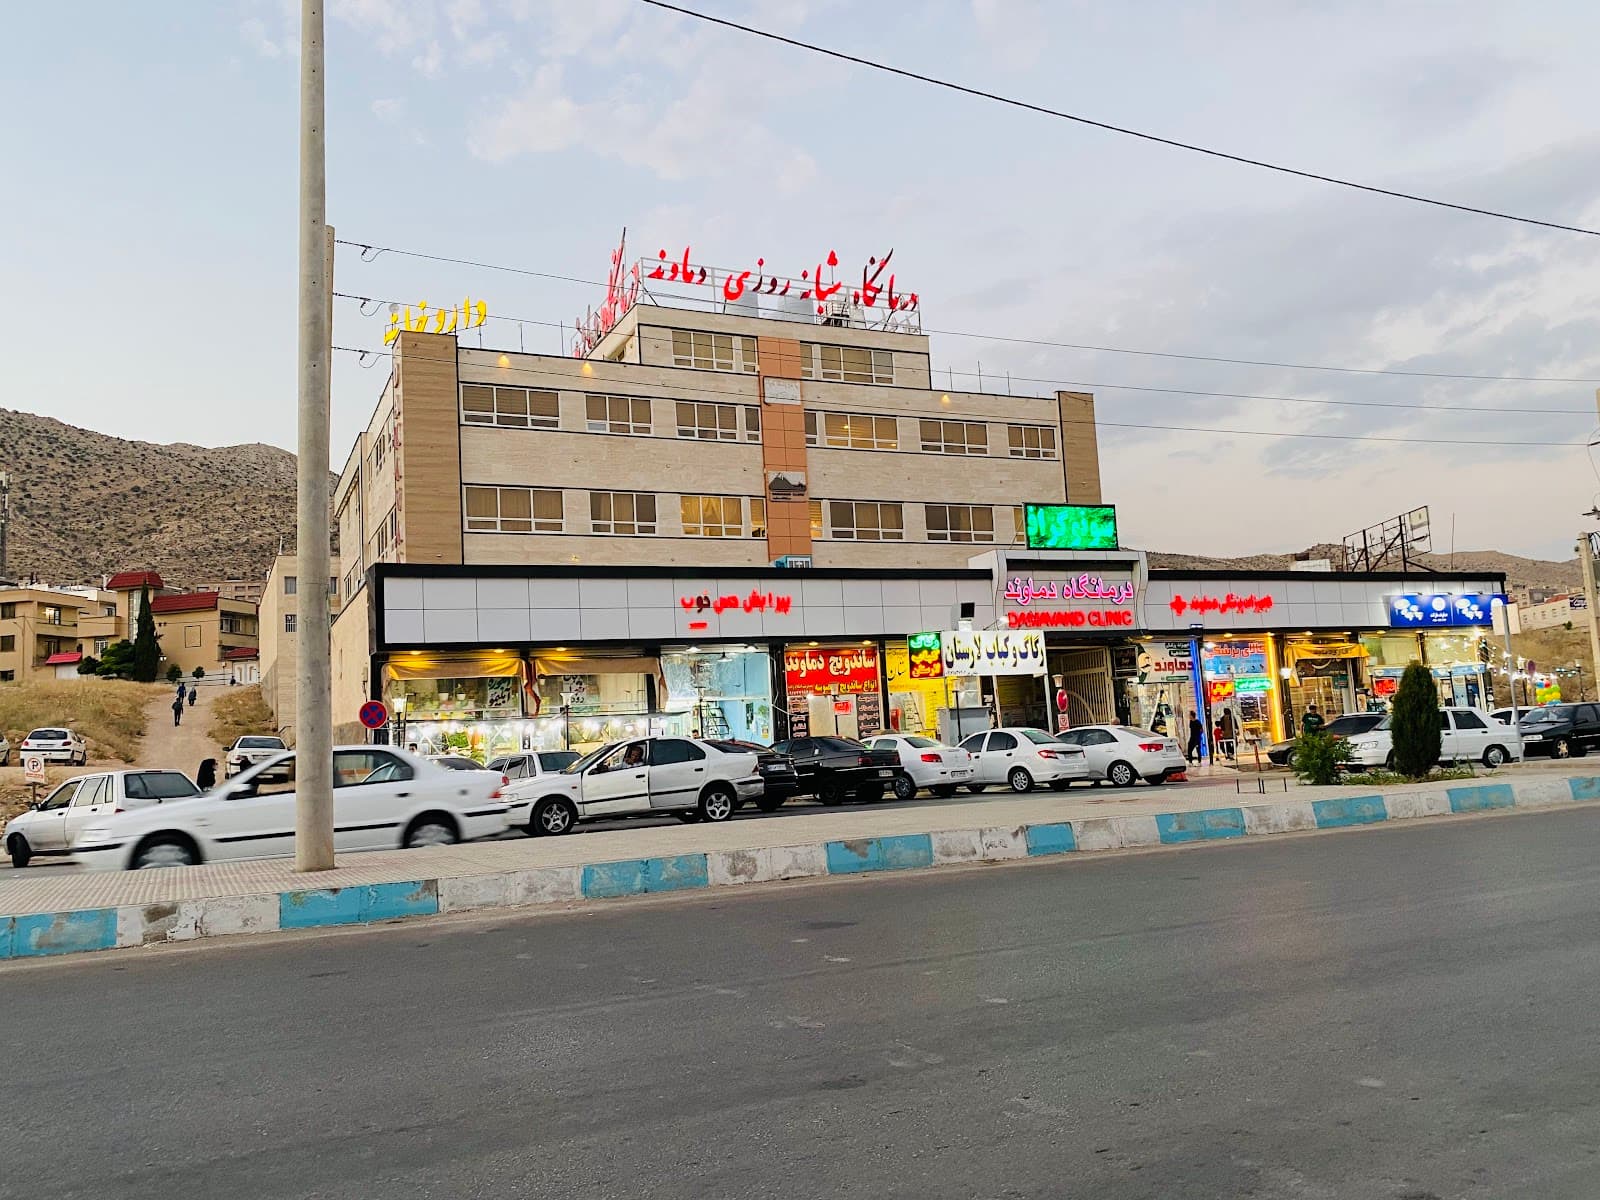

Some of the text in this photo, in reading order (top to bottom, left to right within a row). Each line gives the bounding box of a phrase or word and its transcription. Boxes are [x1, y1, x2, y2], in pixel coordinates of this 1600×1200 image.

[648, 245, 918, 315] درمانگاه شبانه روزی دماوند
[680, 589, 711, 614] خوب
[1003, 573, 1134, 606] درمانگاه دماوند
[1007, 609, 1134, 628] DAMAVAND CLINIC
[829, 649, 876, 676] ساندویچ
[910, 649, 941, 664] کباب
[944, 633, 982, 669] لارستان
[985, 634, 1010, 667] کباب
[1205, 642, 1265, 658] کالای پزشکی
[785, 651, 825, 678] دماوند
[1154, 657, 1195, 677] دماوند
[839, 679, 862, 693] ساندویچ
[863, 679, 877, 692] انواع
